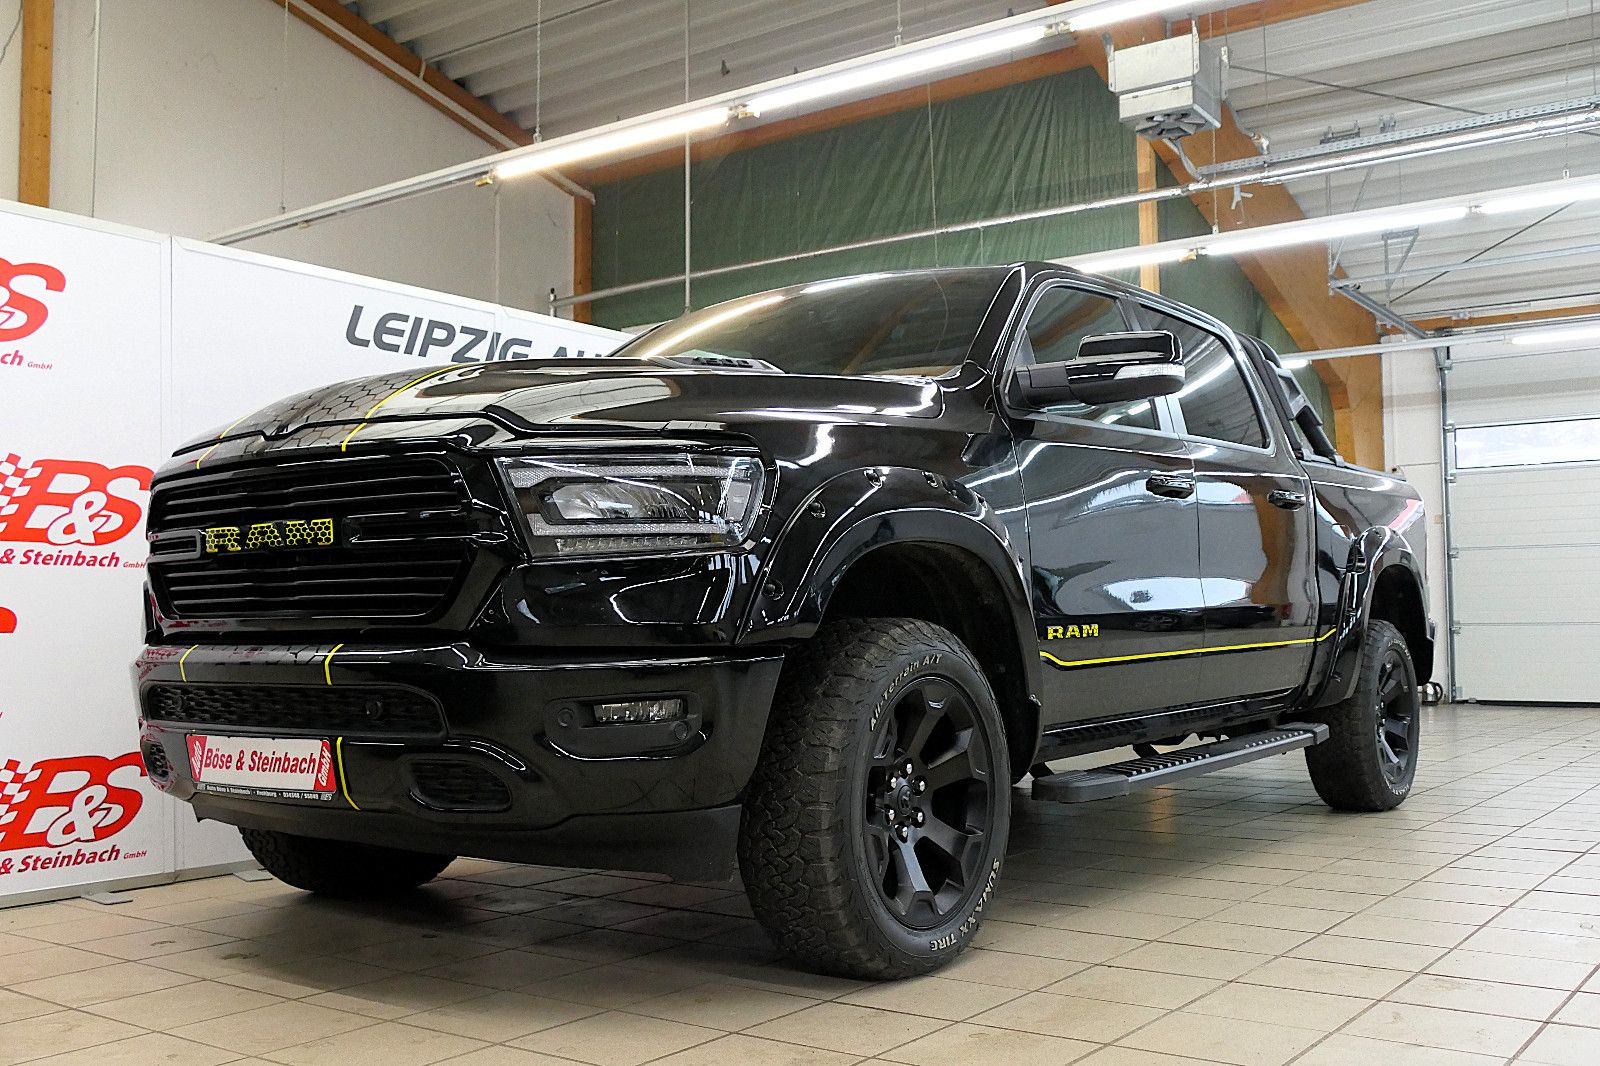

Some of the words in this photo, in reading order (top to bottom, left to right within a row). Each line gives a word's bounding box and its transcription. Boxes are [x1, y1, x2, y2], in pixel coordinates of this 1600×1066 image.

[345, 304, 533, 363] LEIPZIG
[27, 361, 53, 370] GmbH
[205, 518, 334, 553] RAM
[0, 548, 16, 565] &
[20, 548, 120, 568] Steinbach
[123, 561, 146, 569] GmbH
[1046, 623, 1099, 640] RAM
[922, 653, 942, 666] A/T
[204, 747, 233, 769] Böse
[235, 749, 246, 772] &
[248, 750, 317, 775] Steinbach
[317, 746, 332, 787] GmbH
[0, 857, 15, 875] &
[17, 844, 121, 873] Steinbach
[123, 850, 148, 860] GmbH
[930, 933, 958, 951] TIRE
